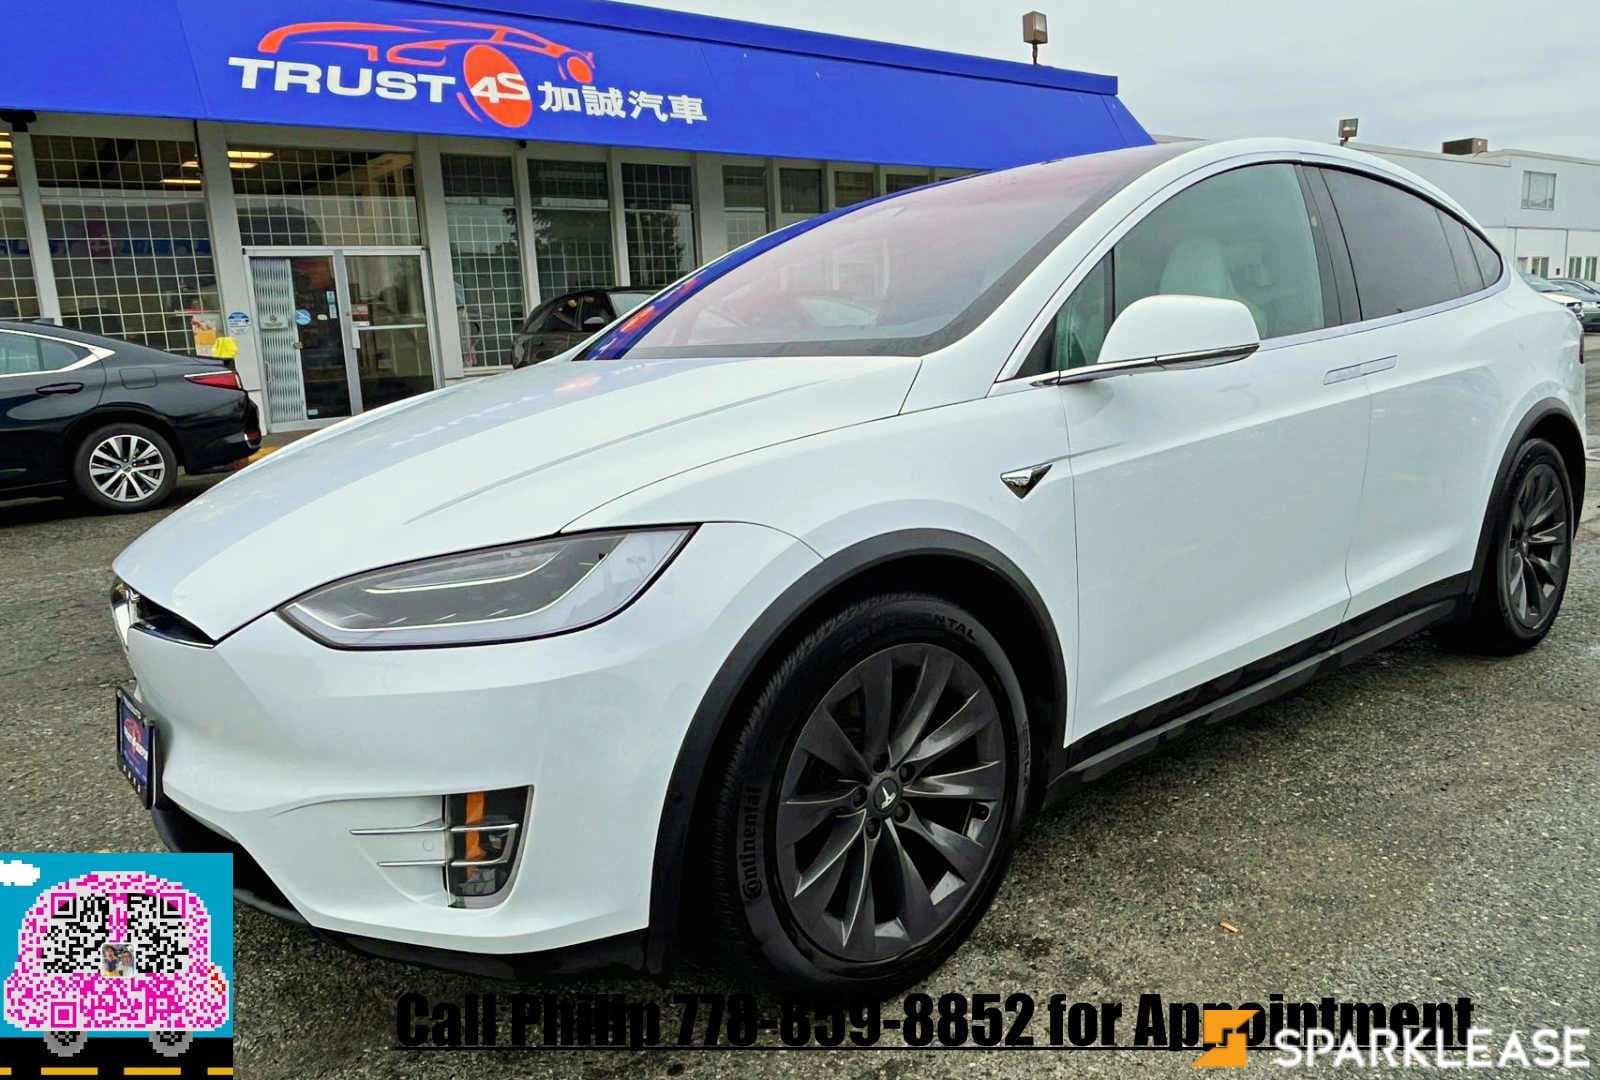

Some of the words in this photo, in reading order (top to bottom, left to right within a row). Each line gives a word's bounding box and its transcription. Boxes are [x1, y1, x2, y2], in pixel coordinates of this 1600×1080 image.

[228, 57, 456, 103] TRUST
[470, 72, 531, 104] 4S
[537, 81, 708, 125] 加誠汽車
